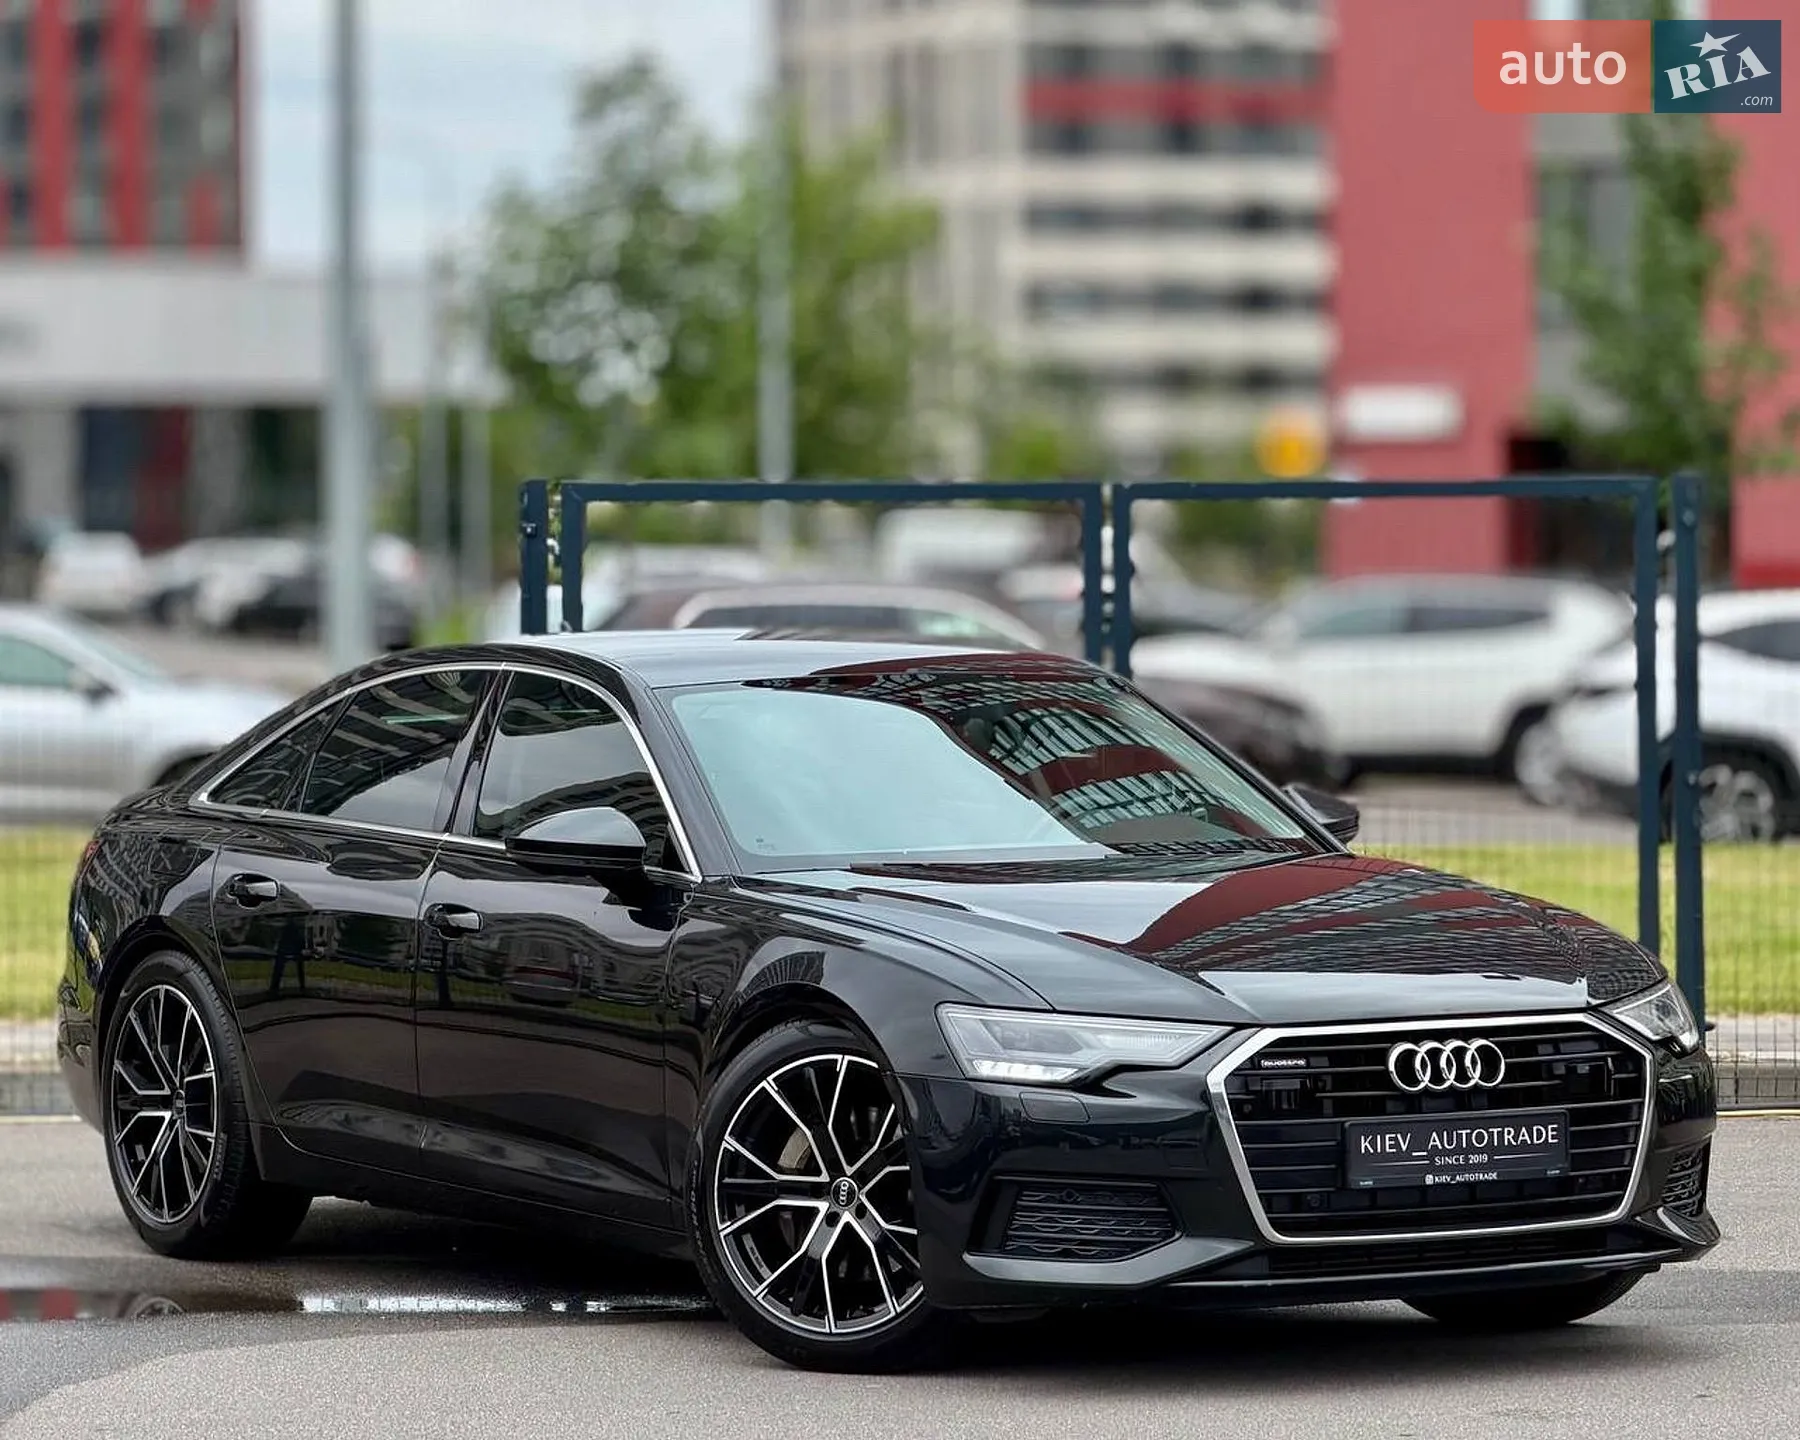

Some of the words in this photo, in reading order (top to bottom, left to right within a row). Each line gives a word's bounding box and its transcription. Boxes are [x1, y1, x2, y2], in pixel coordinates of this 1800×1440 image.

[1360, 1124, 1559, 1156] KIEV_AUTOTRADE
[1434, 1154, 1466, 1166] SINCE
[1467, 1153, 1488, 1164] 2019
